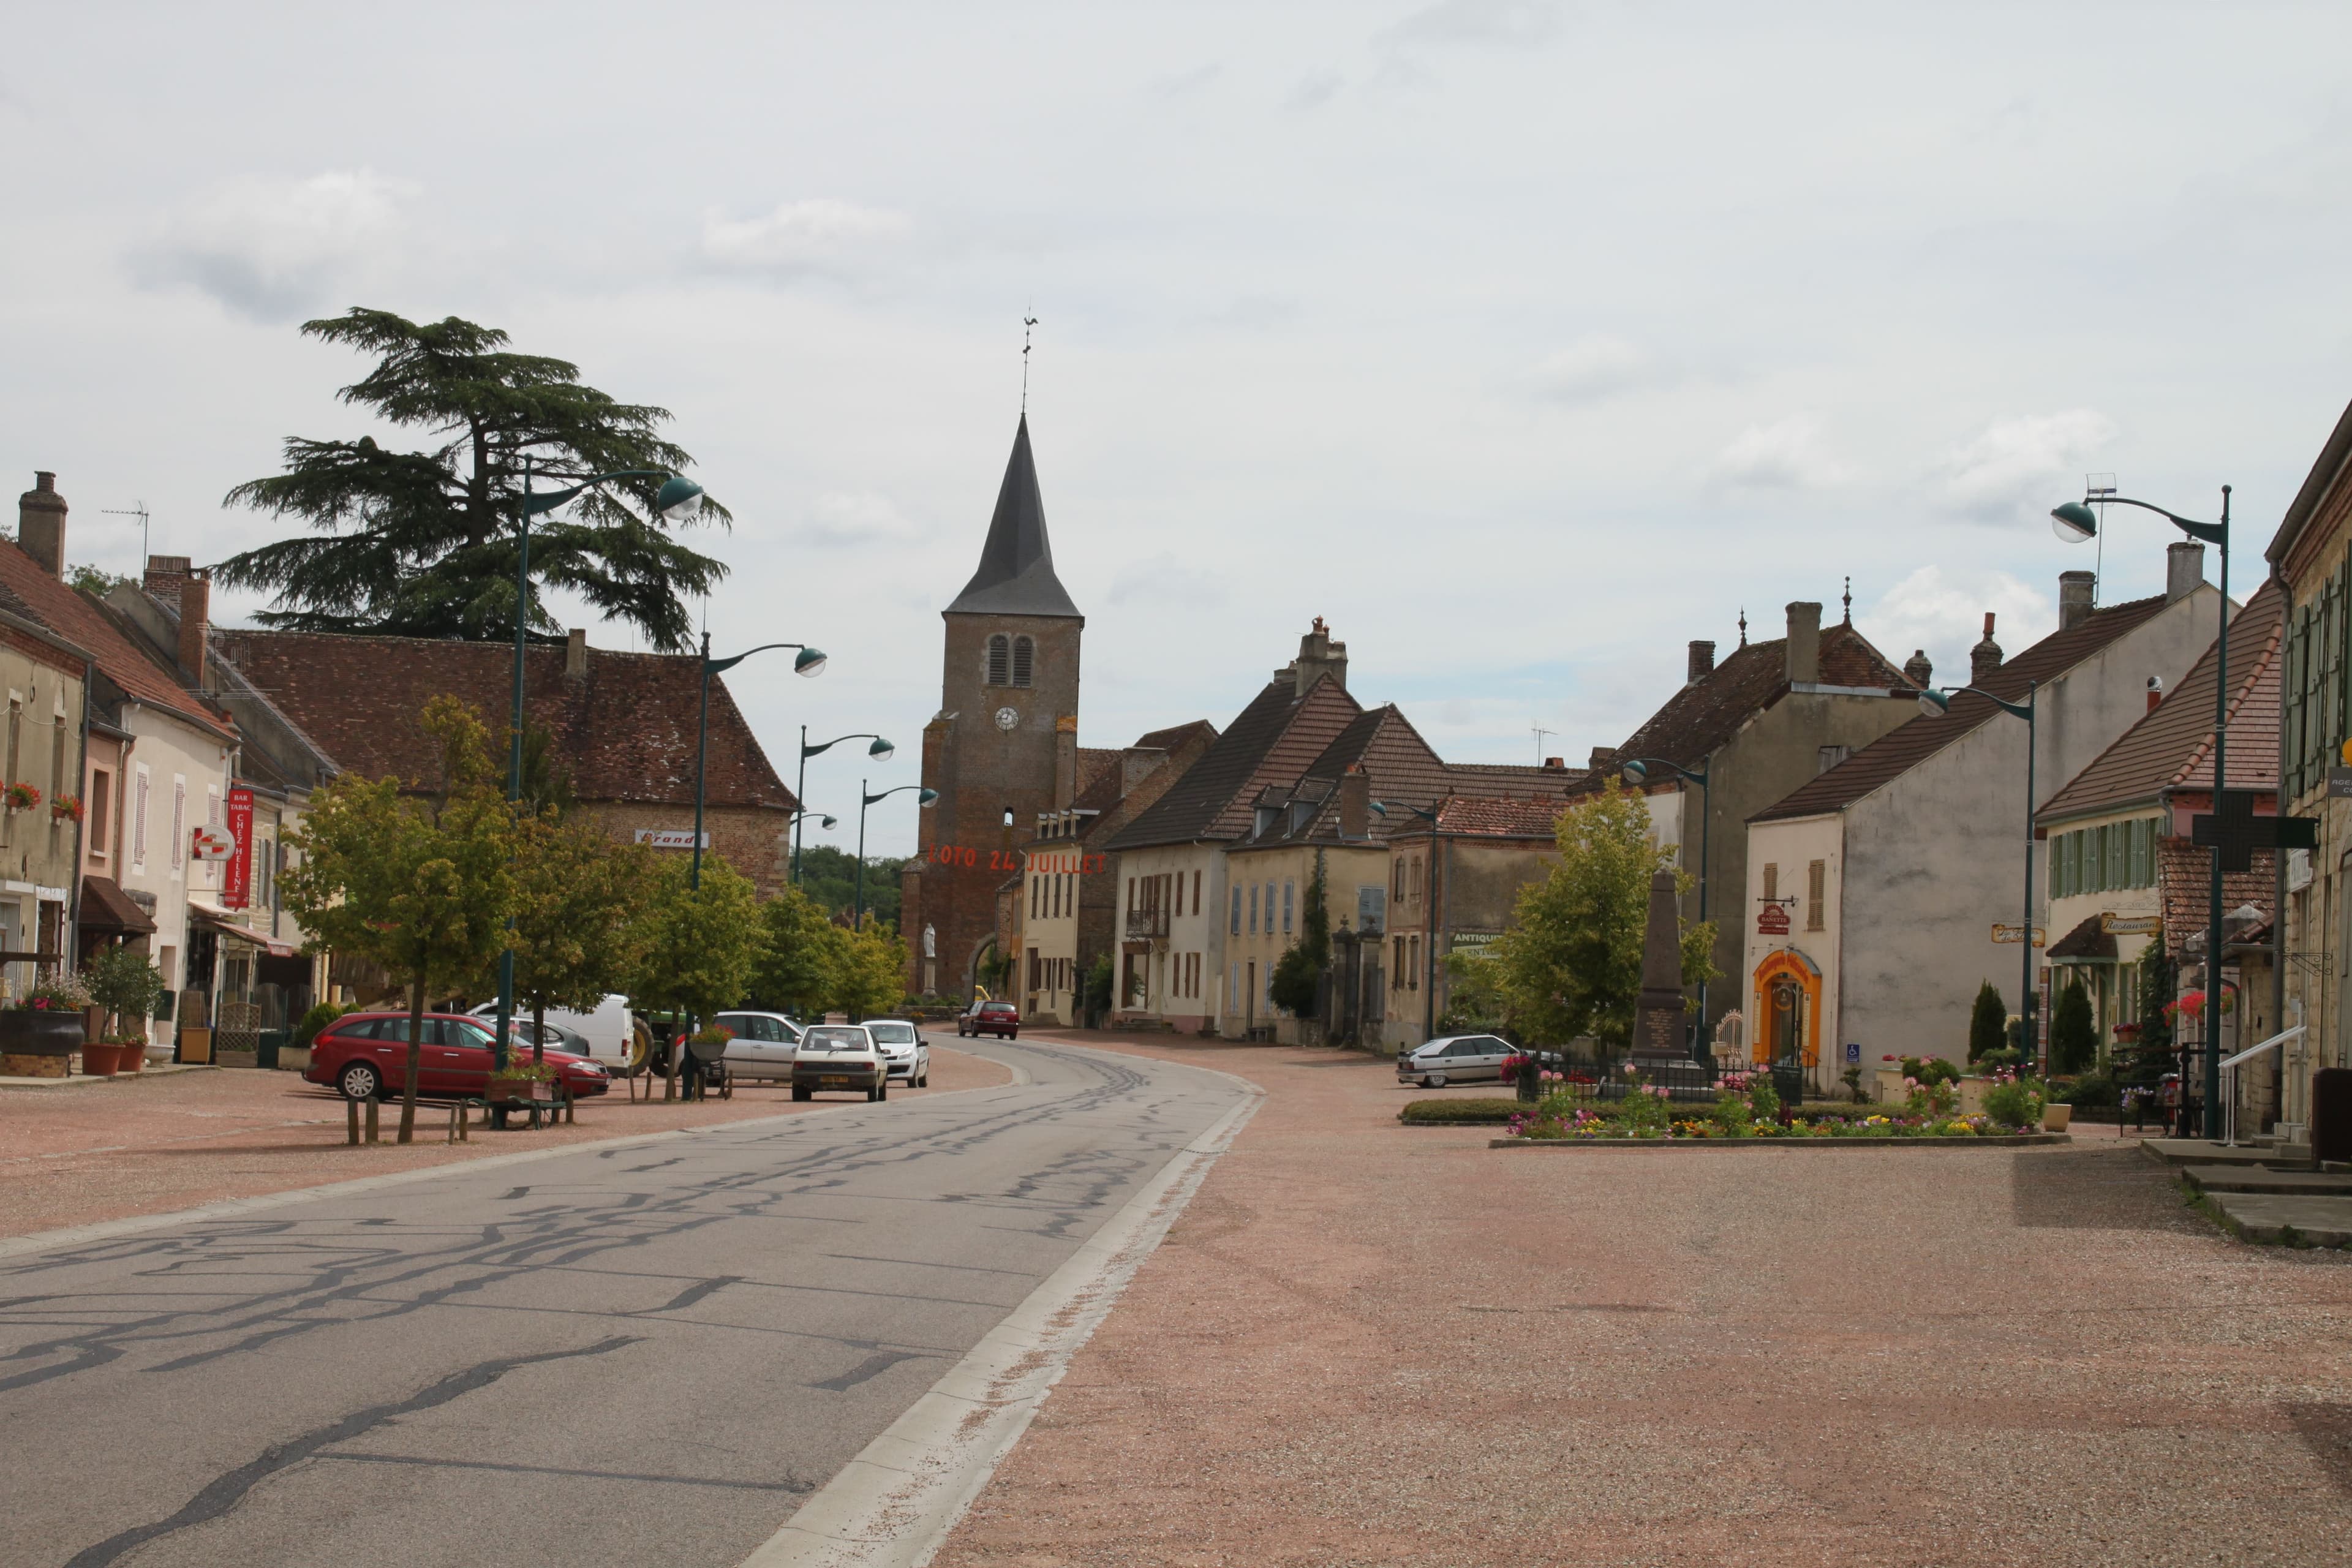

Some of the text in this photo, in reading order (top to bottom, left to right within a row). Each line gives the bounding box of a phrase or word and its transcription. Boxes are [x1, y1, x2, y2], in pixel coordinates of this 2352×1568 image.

[641, 833, 703, 843] Brand
[928, 843, 1106, 874] LOTO 24 JUILLET
[234, 848, 243, 892] HELENE
[2103, 919, 2159, 930] Restaurant
